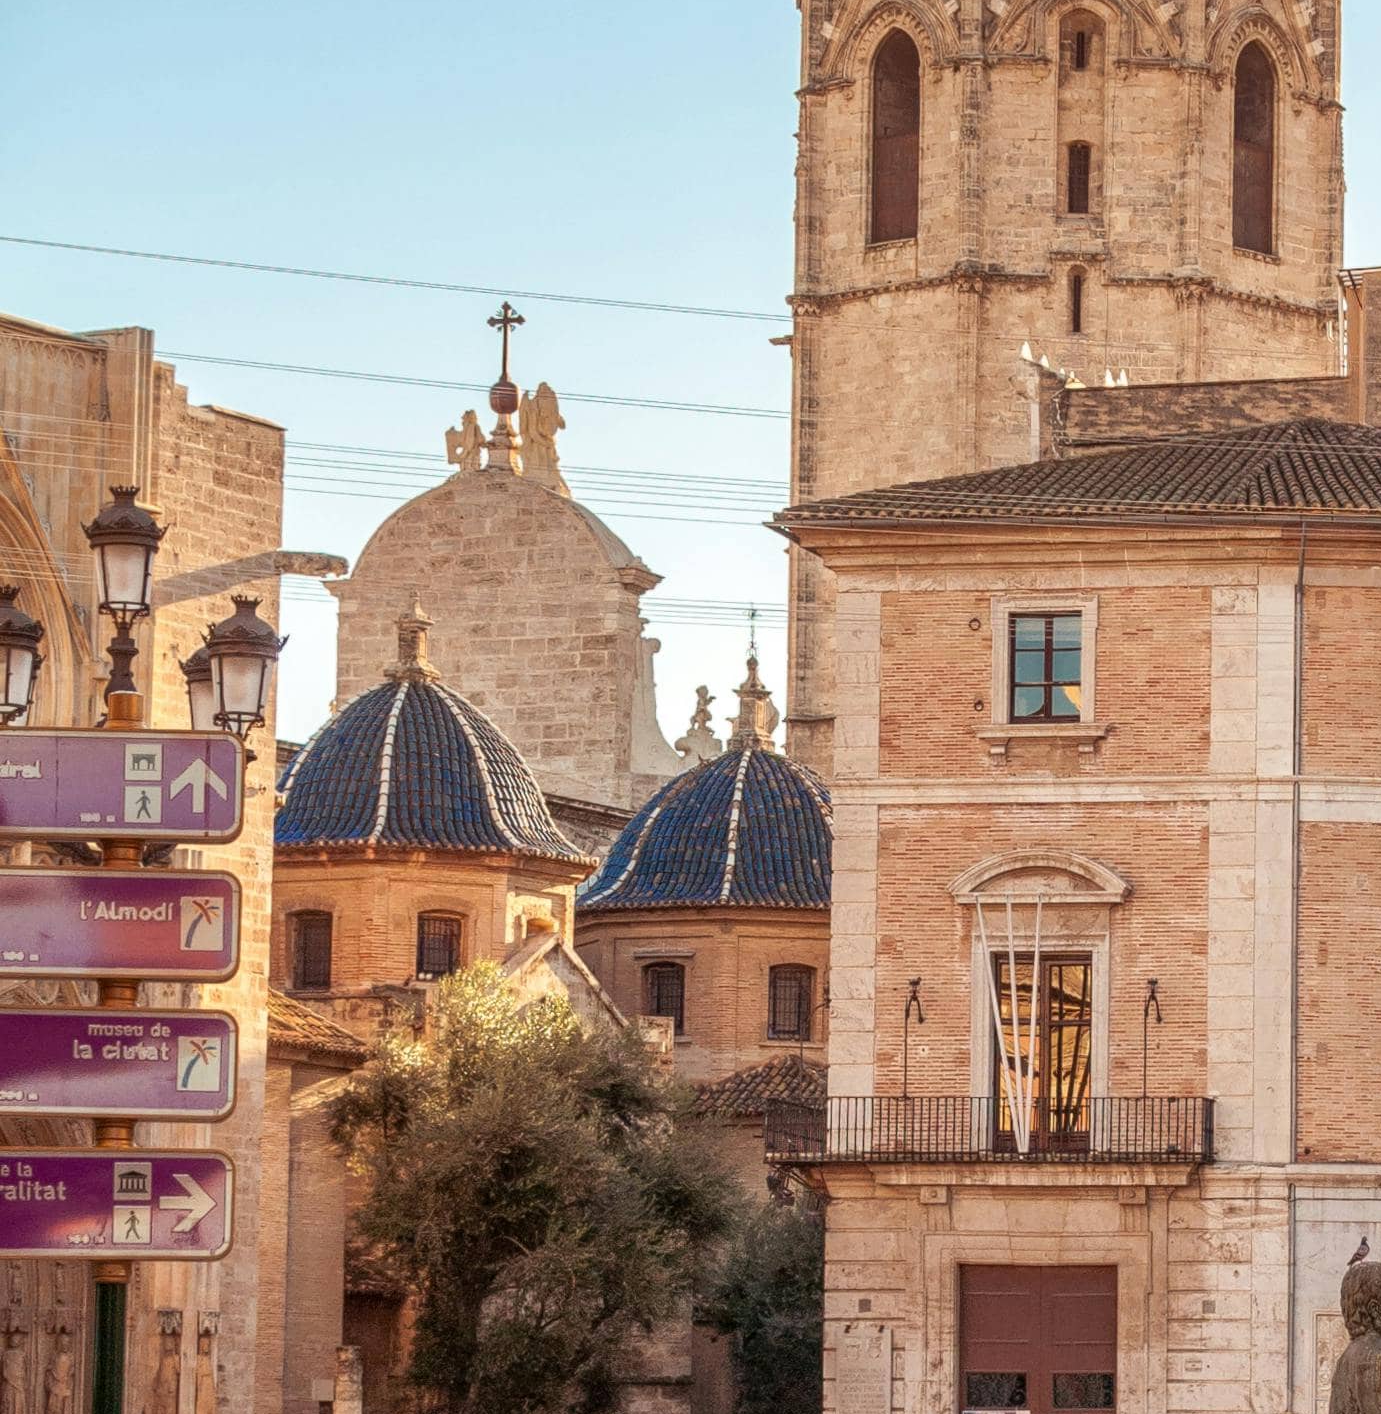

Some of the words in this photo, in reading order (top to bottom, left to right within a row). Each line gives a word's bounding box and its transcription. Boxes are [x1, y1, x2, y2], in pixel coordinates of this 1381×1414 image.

[88, 1024, 144, 1036] museu
[150, 1023, 171, 1037] de
[73, 1040, 93, 1059] la
[102, 1041, 170, 1061] ciutat
[17, 1161, 33, 1177] la
